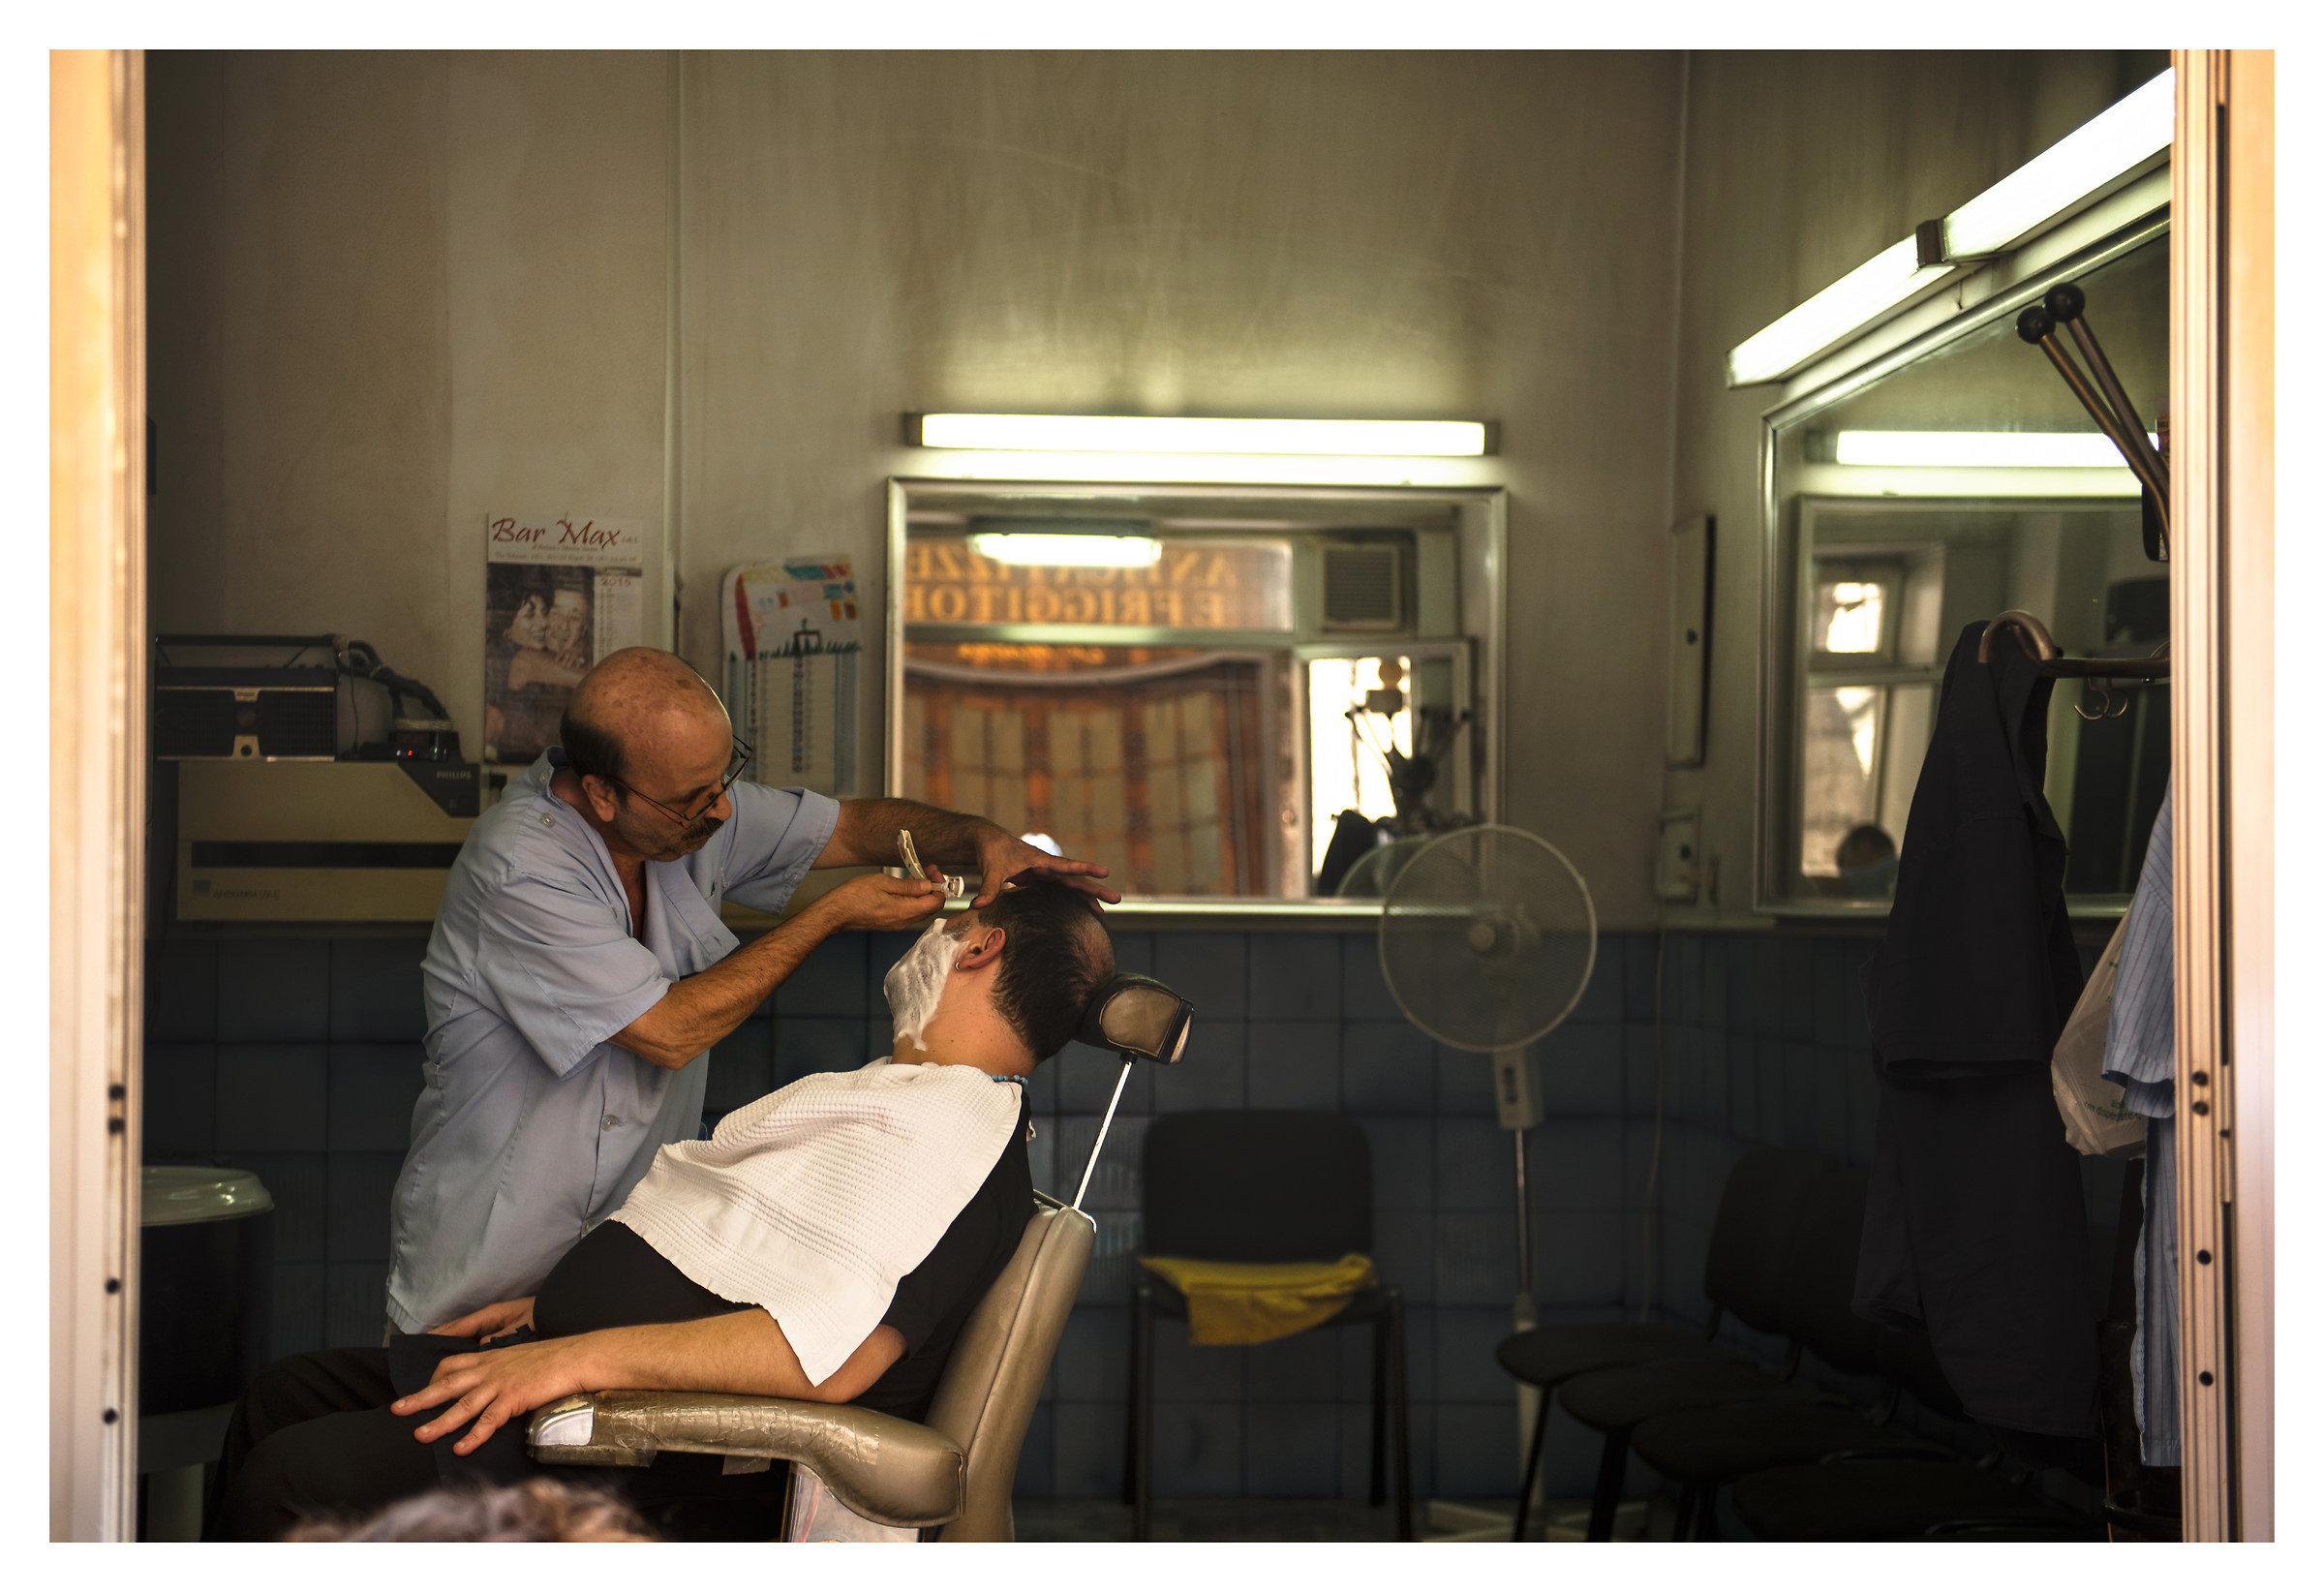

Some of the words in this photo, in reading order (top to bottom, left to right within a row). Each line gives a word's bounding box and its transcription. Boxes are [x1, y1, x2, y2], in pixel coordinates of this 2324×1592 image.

[491, 517, 547, 543] Bar
[556, 519, 622, 549] Max
[437, 770, 472, 781] PHILIPS
